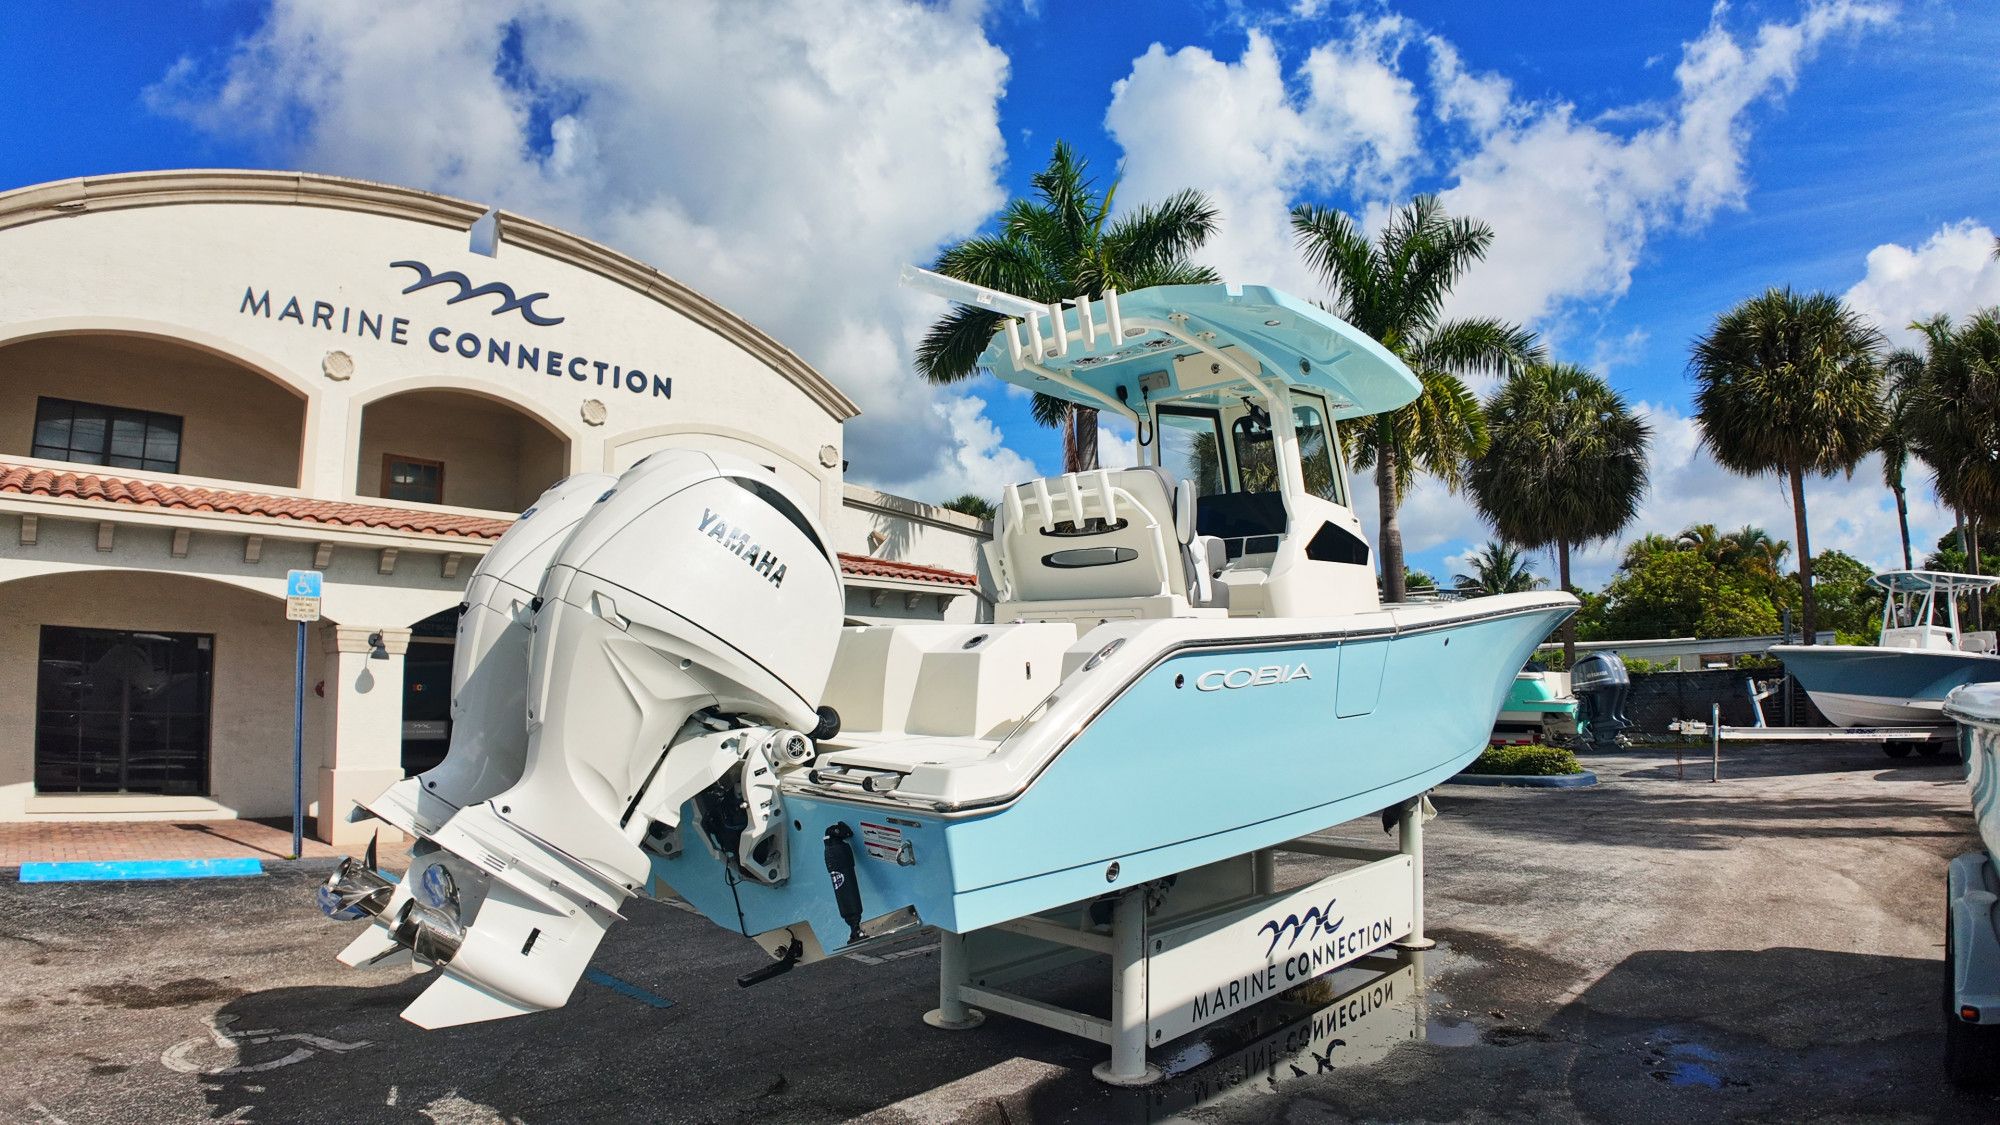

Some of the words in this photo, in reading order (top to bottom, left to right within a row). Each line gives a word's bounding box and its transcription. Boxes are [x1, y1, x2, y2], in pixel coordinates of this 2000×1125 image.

[240, 286, 410, 345] MARINE
[429, 326, 673, 399] CONNECTION
[697, 508, 788, 589] YAMAHA
[1196, 663, 1312, 692] COBIA
[1192, 964, 1277, 1022] MARINE
[1285, 917, 1393, 981] CONNECTION
